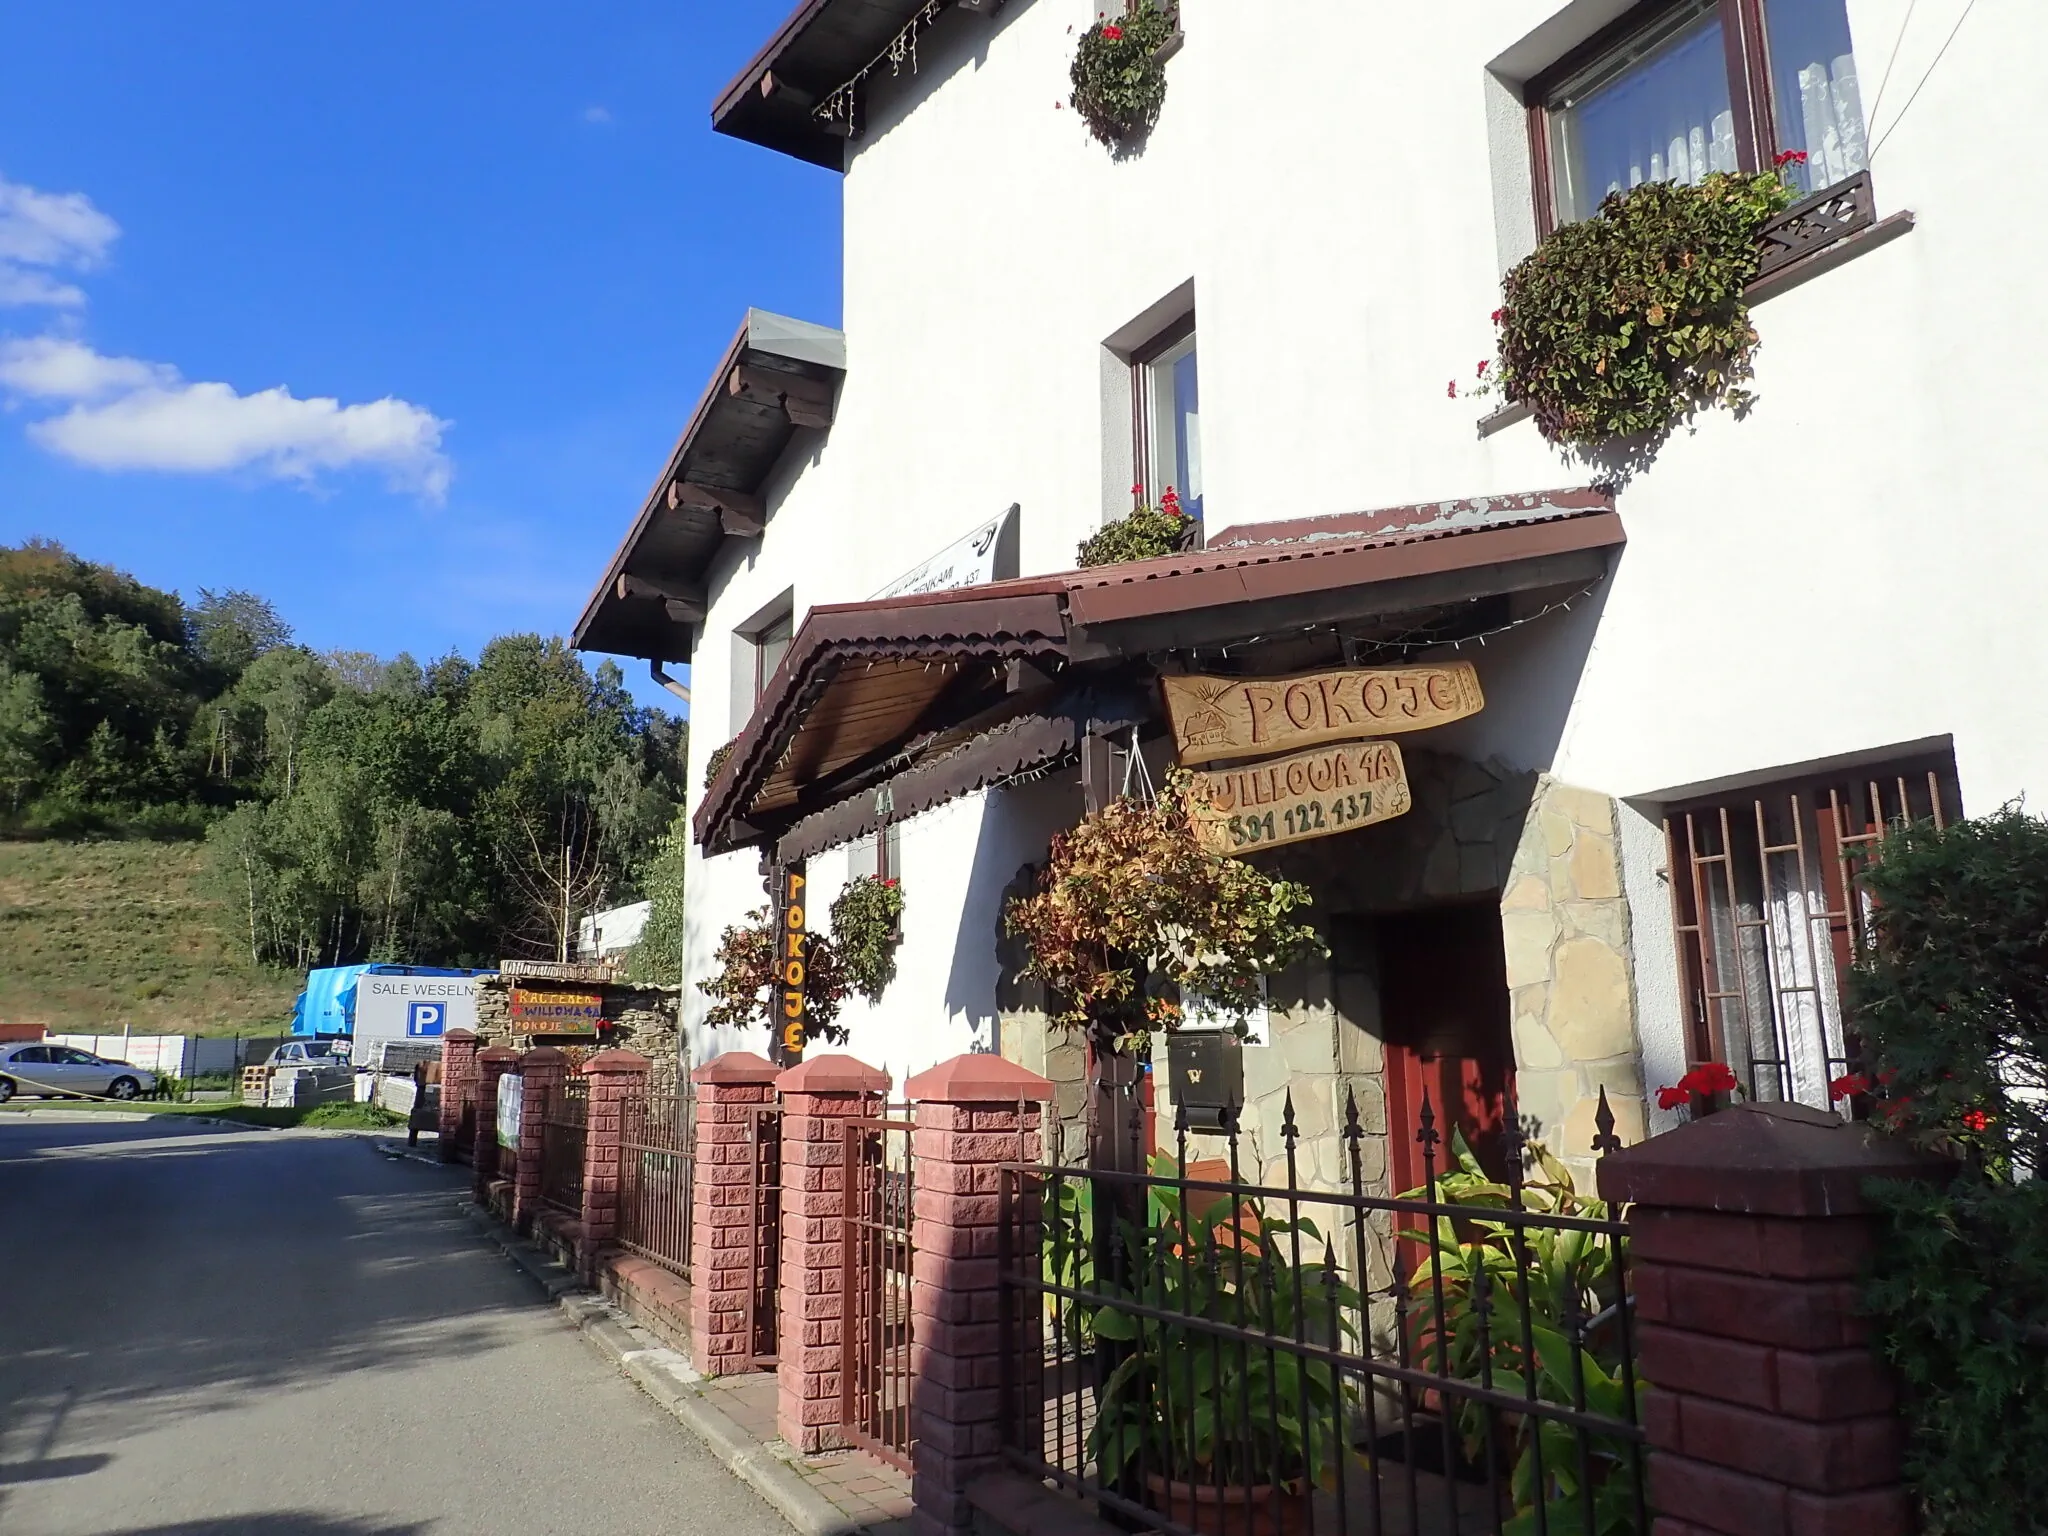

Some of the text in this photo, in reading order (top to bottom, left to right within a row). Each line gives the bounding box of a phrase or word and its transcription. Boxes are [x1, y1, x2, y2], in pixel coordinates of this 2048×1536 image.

[964, 568, 980, 588] 437
[1244, 674, 1456, 743] POKOJE
[1207, 747, 1396, 812] WILLOWA 4A
[1229, 791, 1373, 846] 501 122 437
[784, 874, 805, 1052] POKOJE
[372, 983, 474, 996] SALE WESELN
[414, 1006, 439, 1034] P
[514, 1021, 562, 1031] POKOJE
